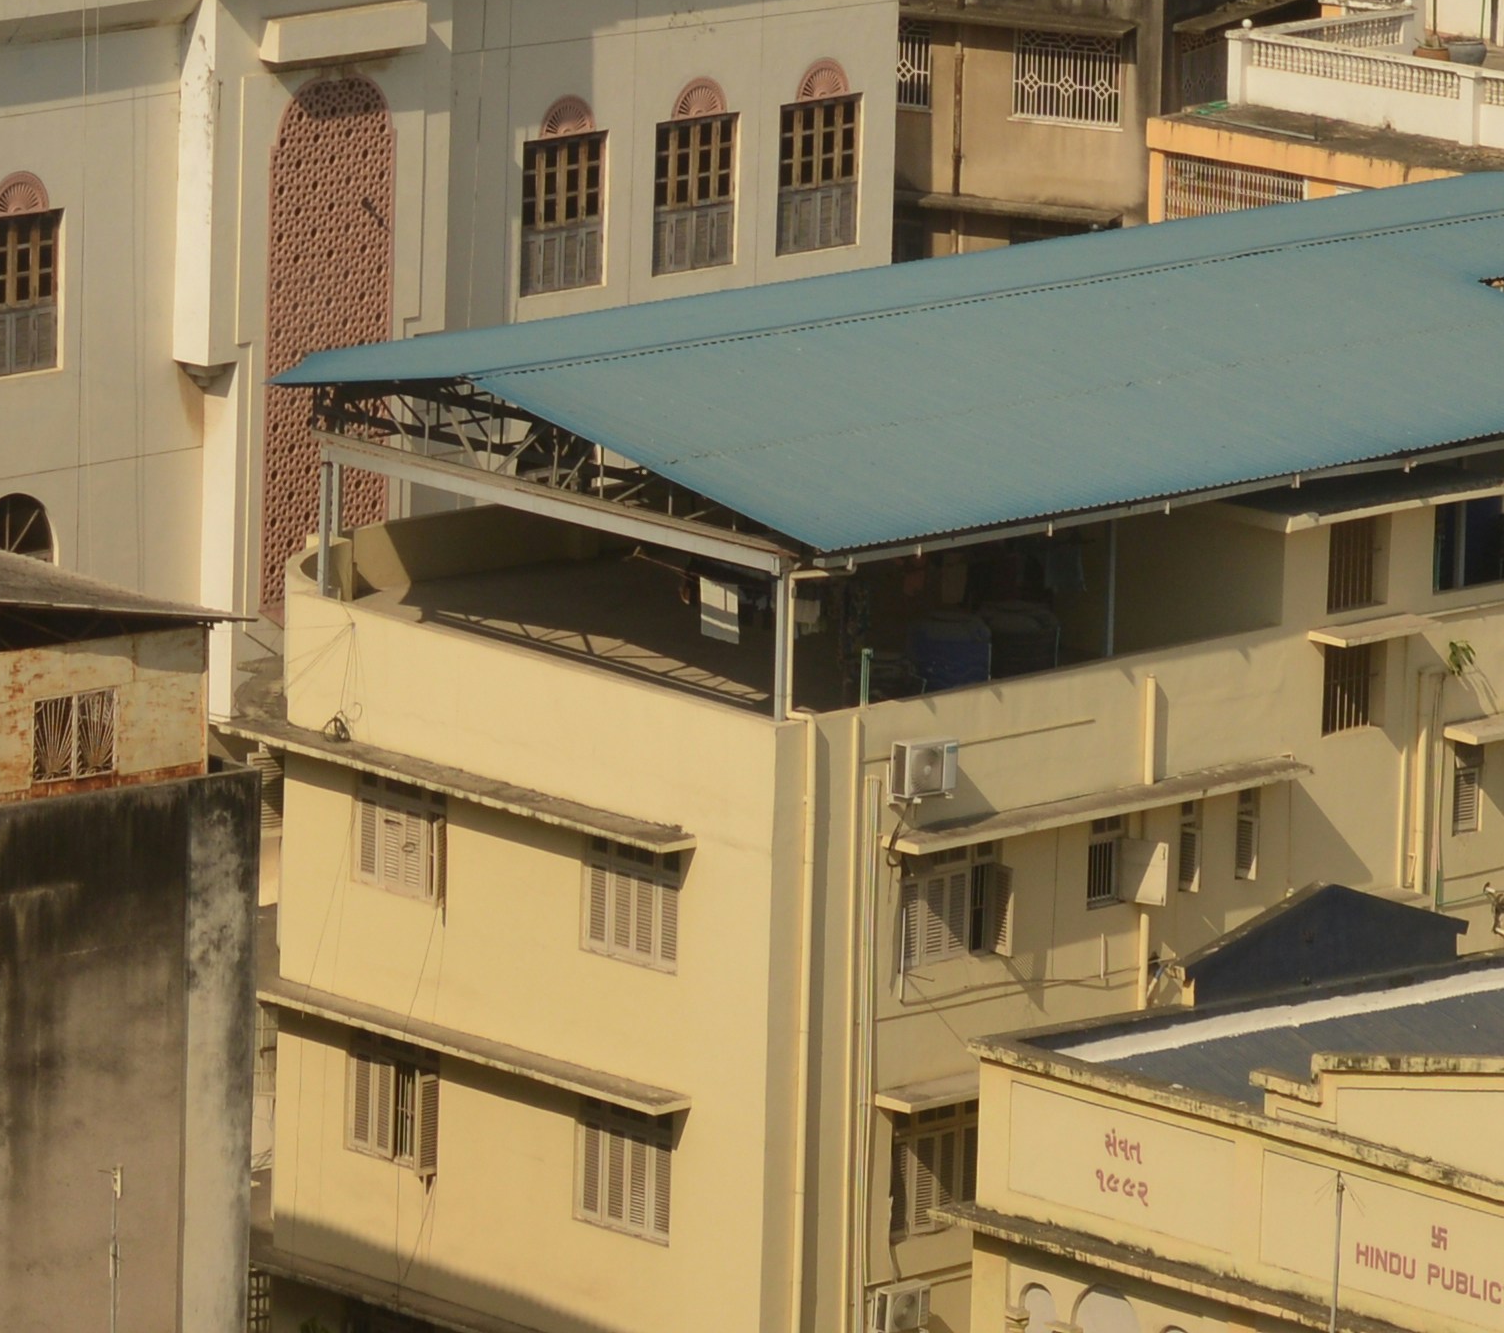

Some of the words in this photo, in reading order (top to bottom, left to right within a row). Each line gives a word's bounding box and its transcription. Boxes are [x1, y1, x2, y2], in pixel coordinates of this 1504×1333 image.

[1105, 1128, 1142, 1165] સંવત
[1096, 1169, 1149, 1207] ૧૯૯૨
[1355, 1242, 1416, 1280] HINDU
[1427, 1262, 1502, 1305] PUBLIC
